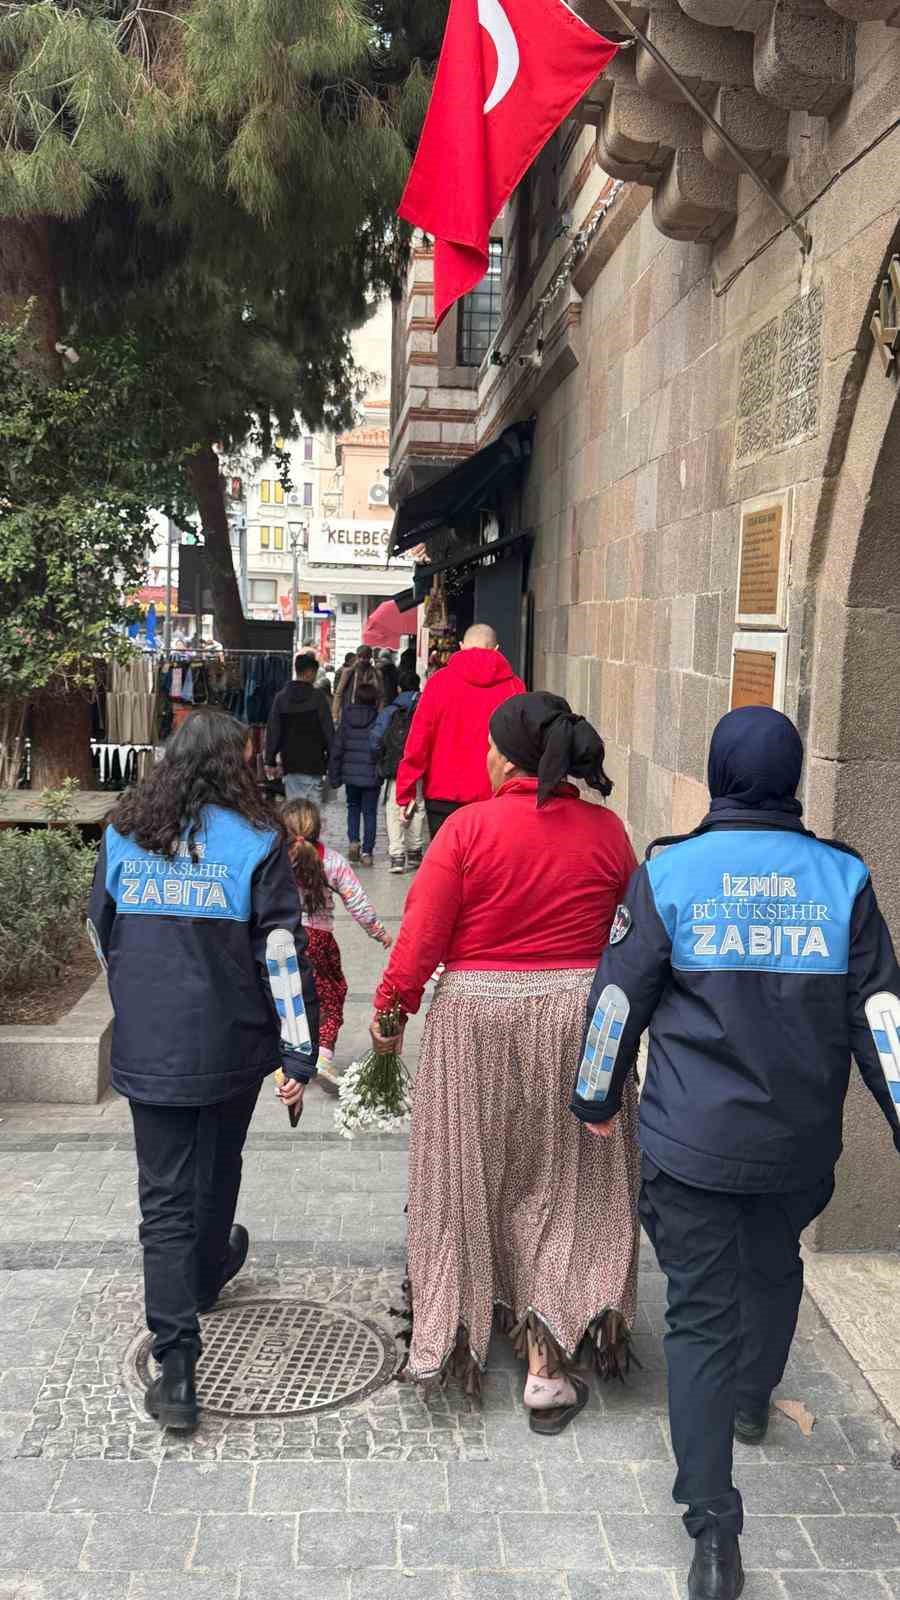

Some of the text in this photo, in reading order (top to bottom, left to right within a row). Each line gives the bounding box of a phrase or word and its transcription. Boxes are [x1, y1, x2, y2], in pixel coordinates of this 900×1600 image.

[121, 878, 227, 909] ZABITA
[722, 872, 797, 897] İZMİR
[691, 899, 832, 924] BÜYÜKŞEHİR
[692, 925, 831, 958] ZABITA
